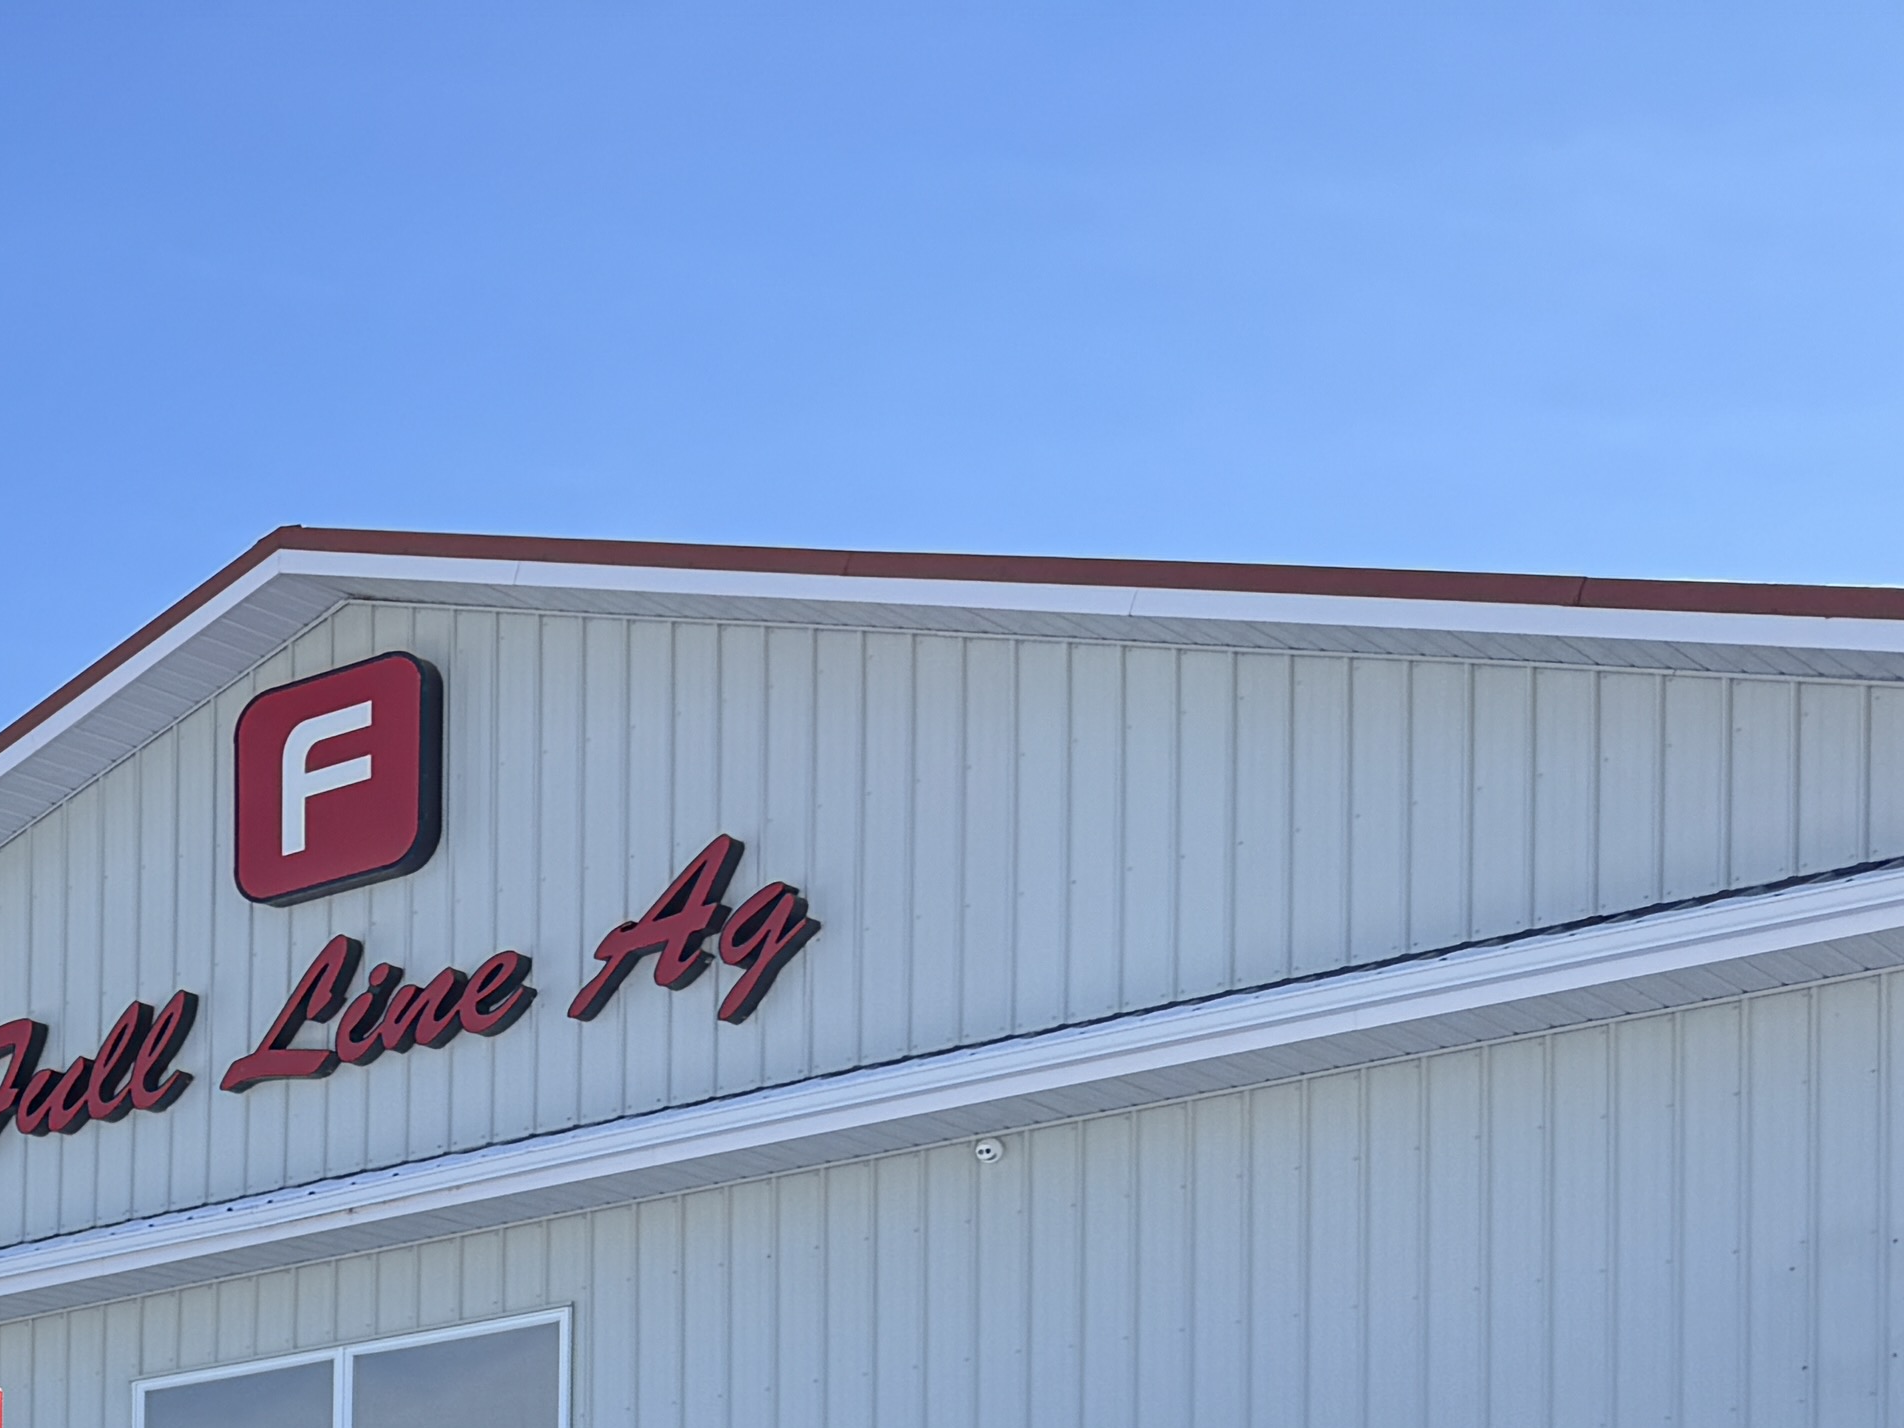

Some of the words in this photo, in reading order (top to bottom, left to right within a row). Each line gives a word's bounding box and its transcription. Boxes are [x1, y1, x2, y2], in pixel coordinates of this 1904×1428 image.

[281, 699, 373, 857] F
[220, 934, 537, 1094] Line
[567, 833, 822, 1026] Ag
